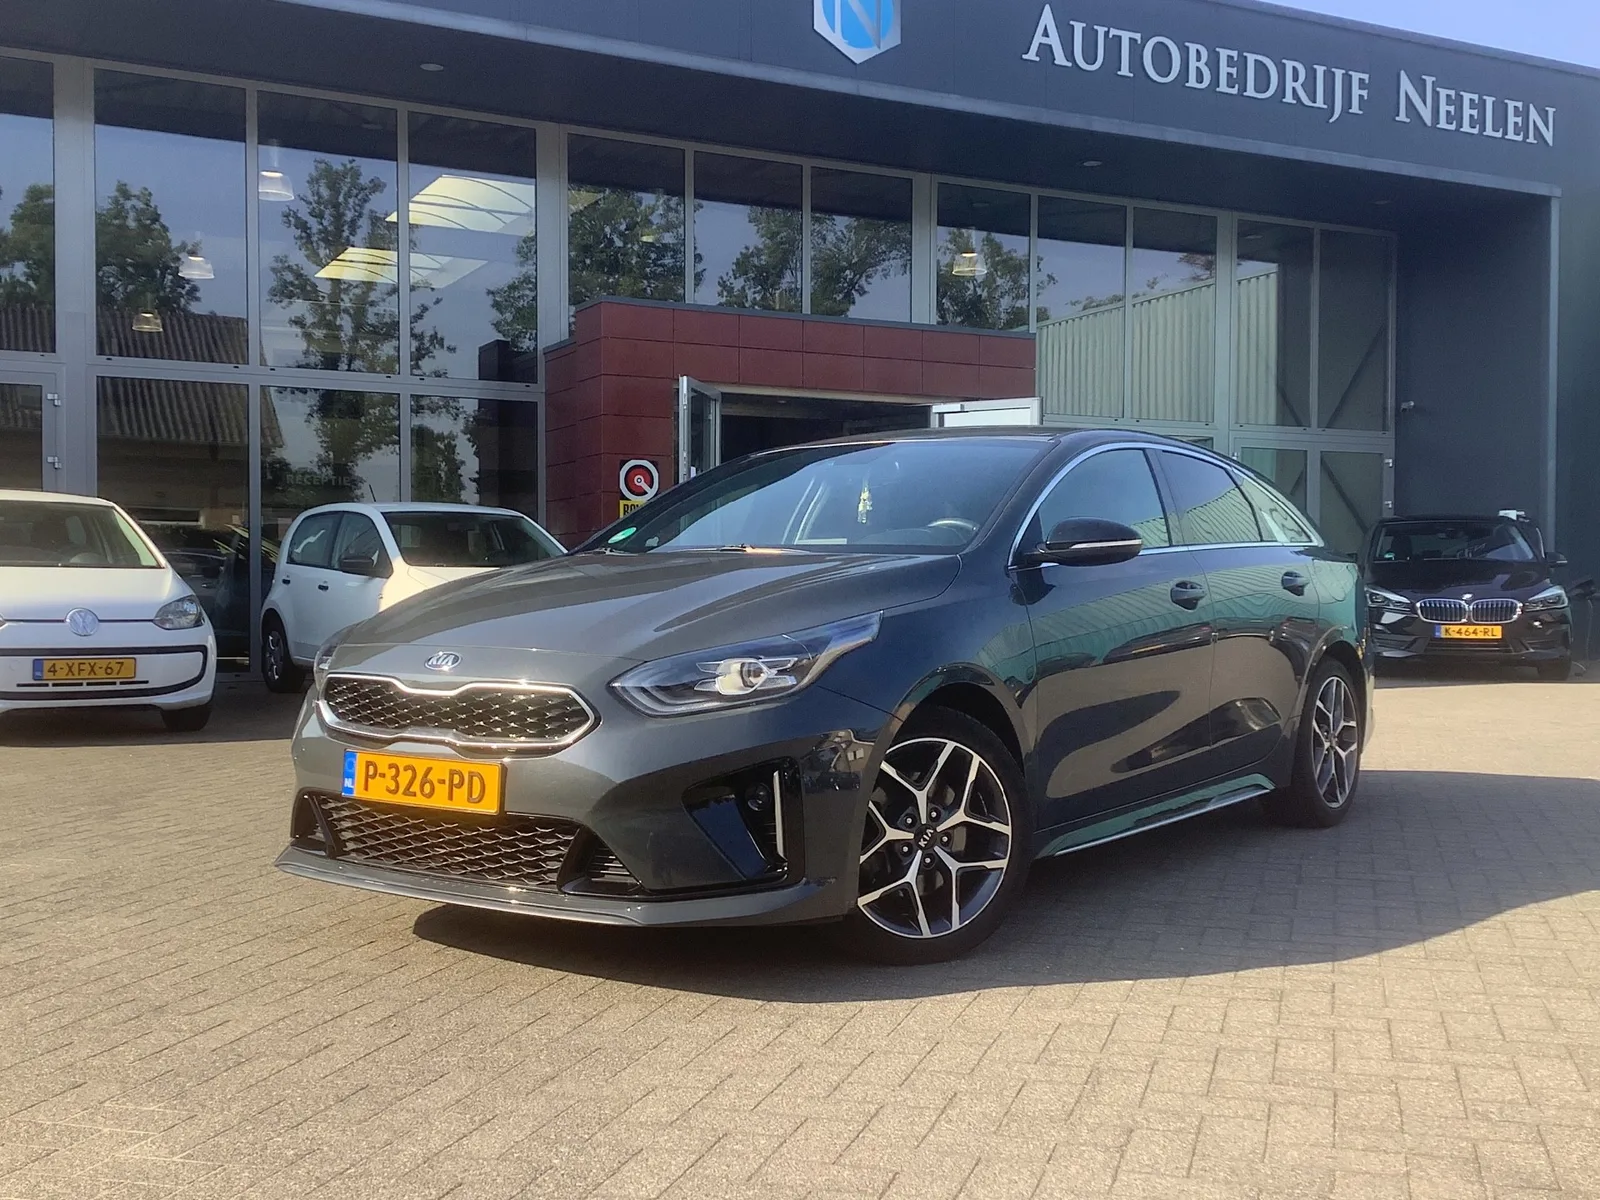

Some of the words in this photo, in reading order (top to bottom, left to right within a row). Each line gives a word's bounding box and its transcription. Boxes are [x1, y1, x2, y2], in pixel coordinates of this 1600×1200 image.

[1021, 3, 1370, 123] AUTOBEDRIJF
[1395, 69, 1557, 147] NEELEN
[286, 473, 352, 486] RECEPTIE
[1444, 626, 1498, 637] K-464-RL
[47, 661, 125, 677] 4-XFX-67
[344, 777, 355, 789] NL
[363, 760, 486, 804] P-326-PD
[918, 828, 934, 847] KIA
